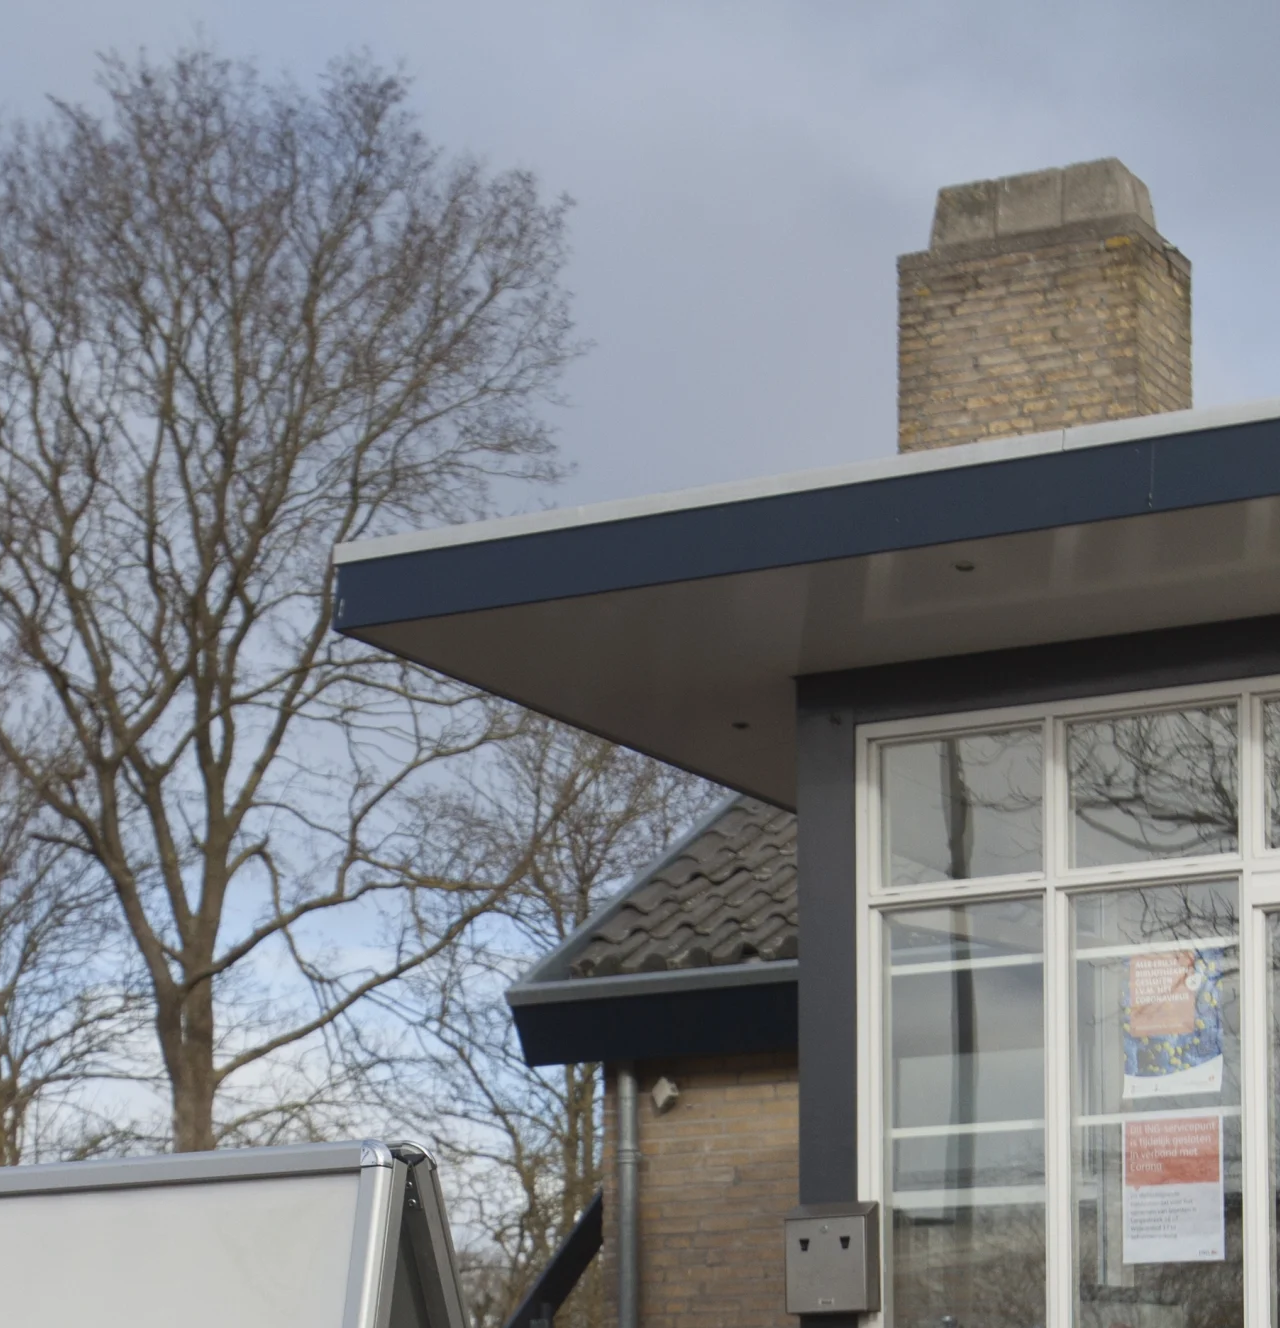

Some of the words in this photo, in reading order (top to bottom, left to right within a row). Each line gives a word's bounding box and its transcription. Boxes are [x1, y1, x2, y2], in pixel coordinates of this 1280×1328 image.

[1172, 1134, 1212, 1147] gesloten
[1141, 1148, 1177, 1160] verband
[1179, 1147, 1199, 1157] met
[1130, 1162, 1163, 1173] Corona
